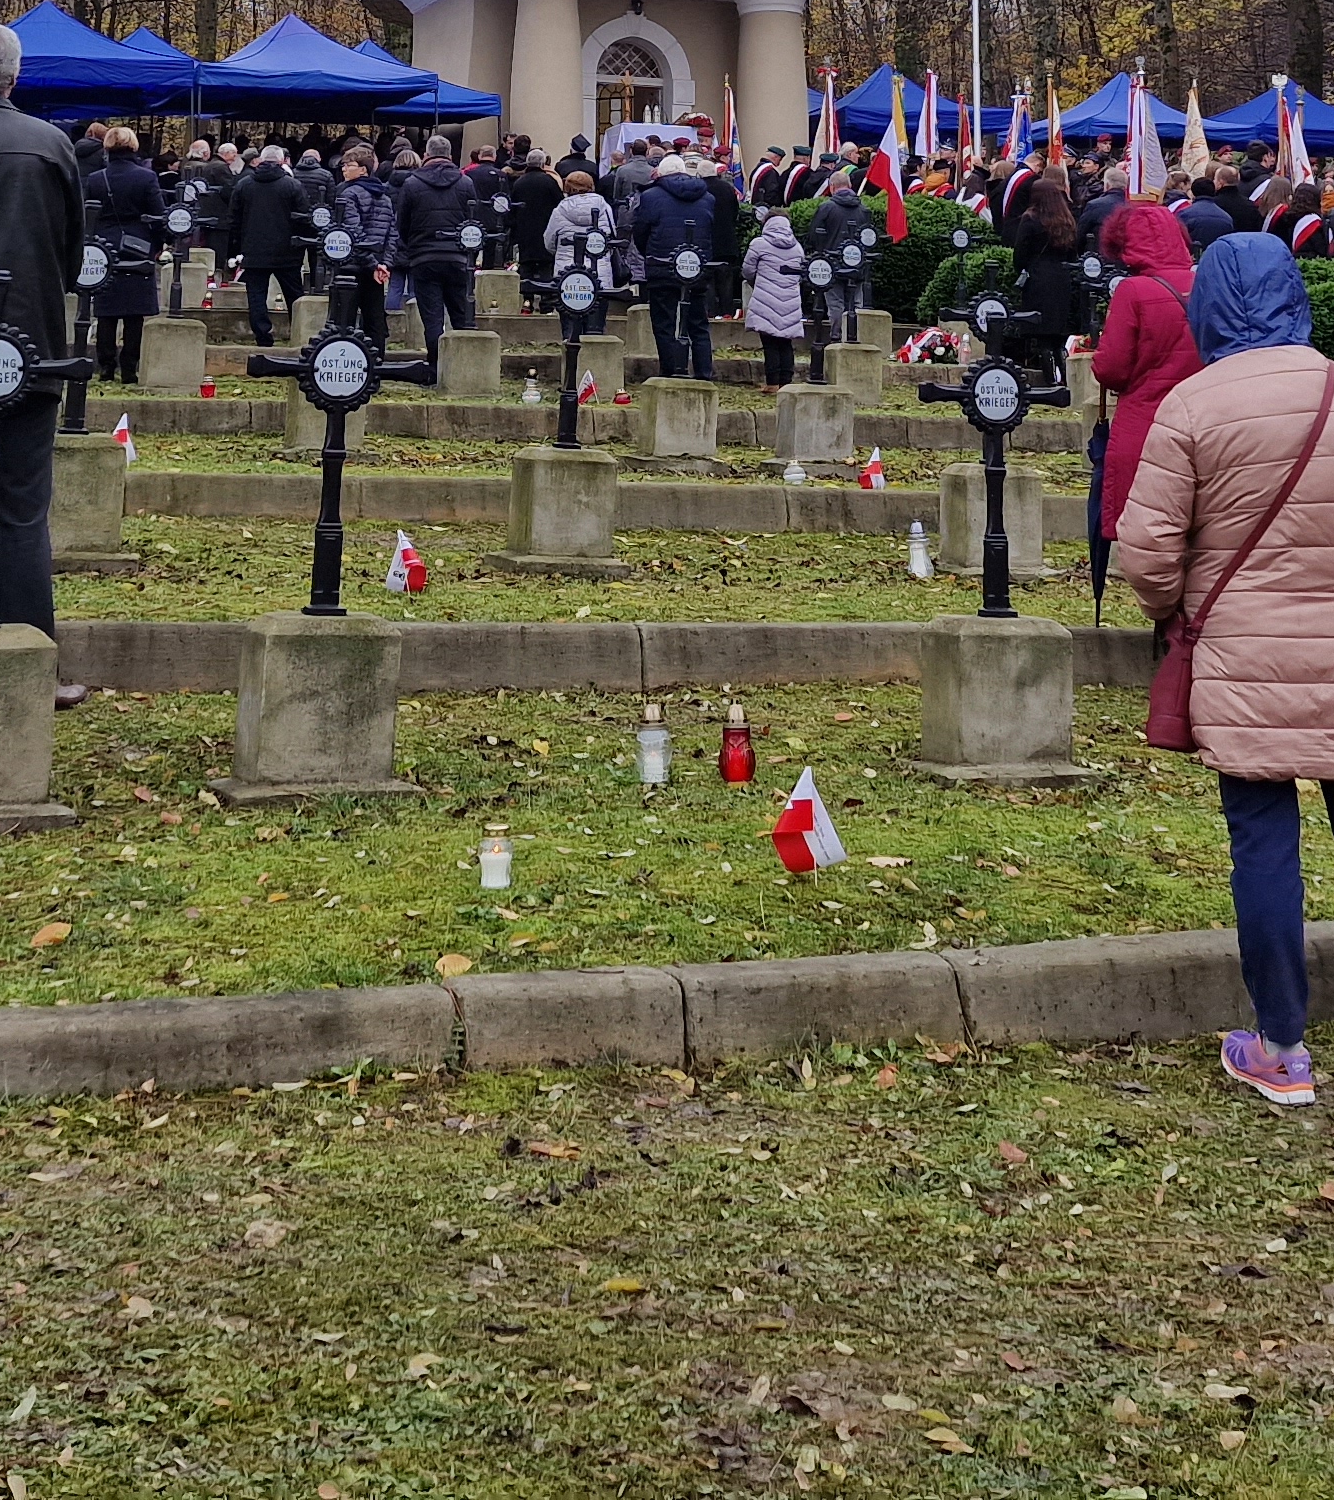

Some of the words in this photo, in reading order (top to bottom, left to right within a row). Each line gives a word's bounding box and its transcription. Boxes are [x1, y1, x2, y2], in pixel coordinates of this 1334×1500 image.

[82, 266, 106, 275] IEGER
[339, 349, 346, 357] 2
[343, 359, 363, 369] UNG
[319, 371, 365, 383] KRIEGER
[995, 376, 1001, 384] 2
[998, 386, 1015, 395] UNG
[978, 397, 1016, 408] KRIEGER
